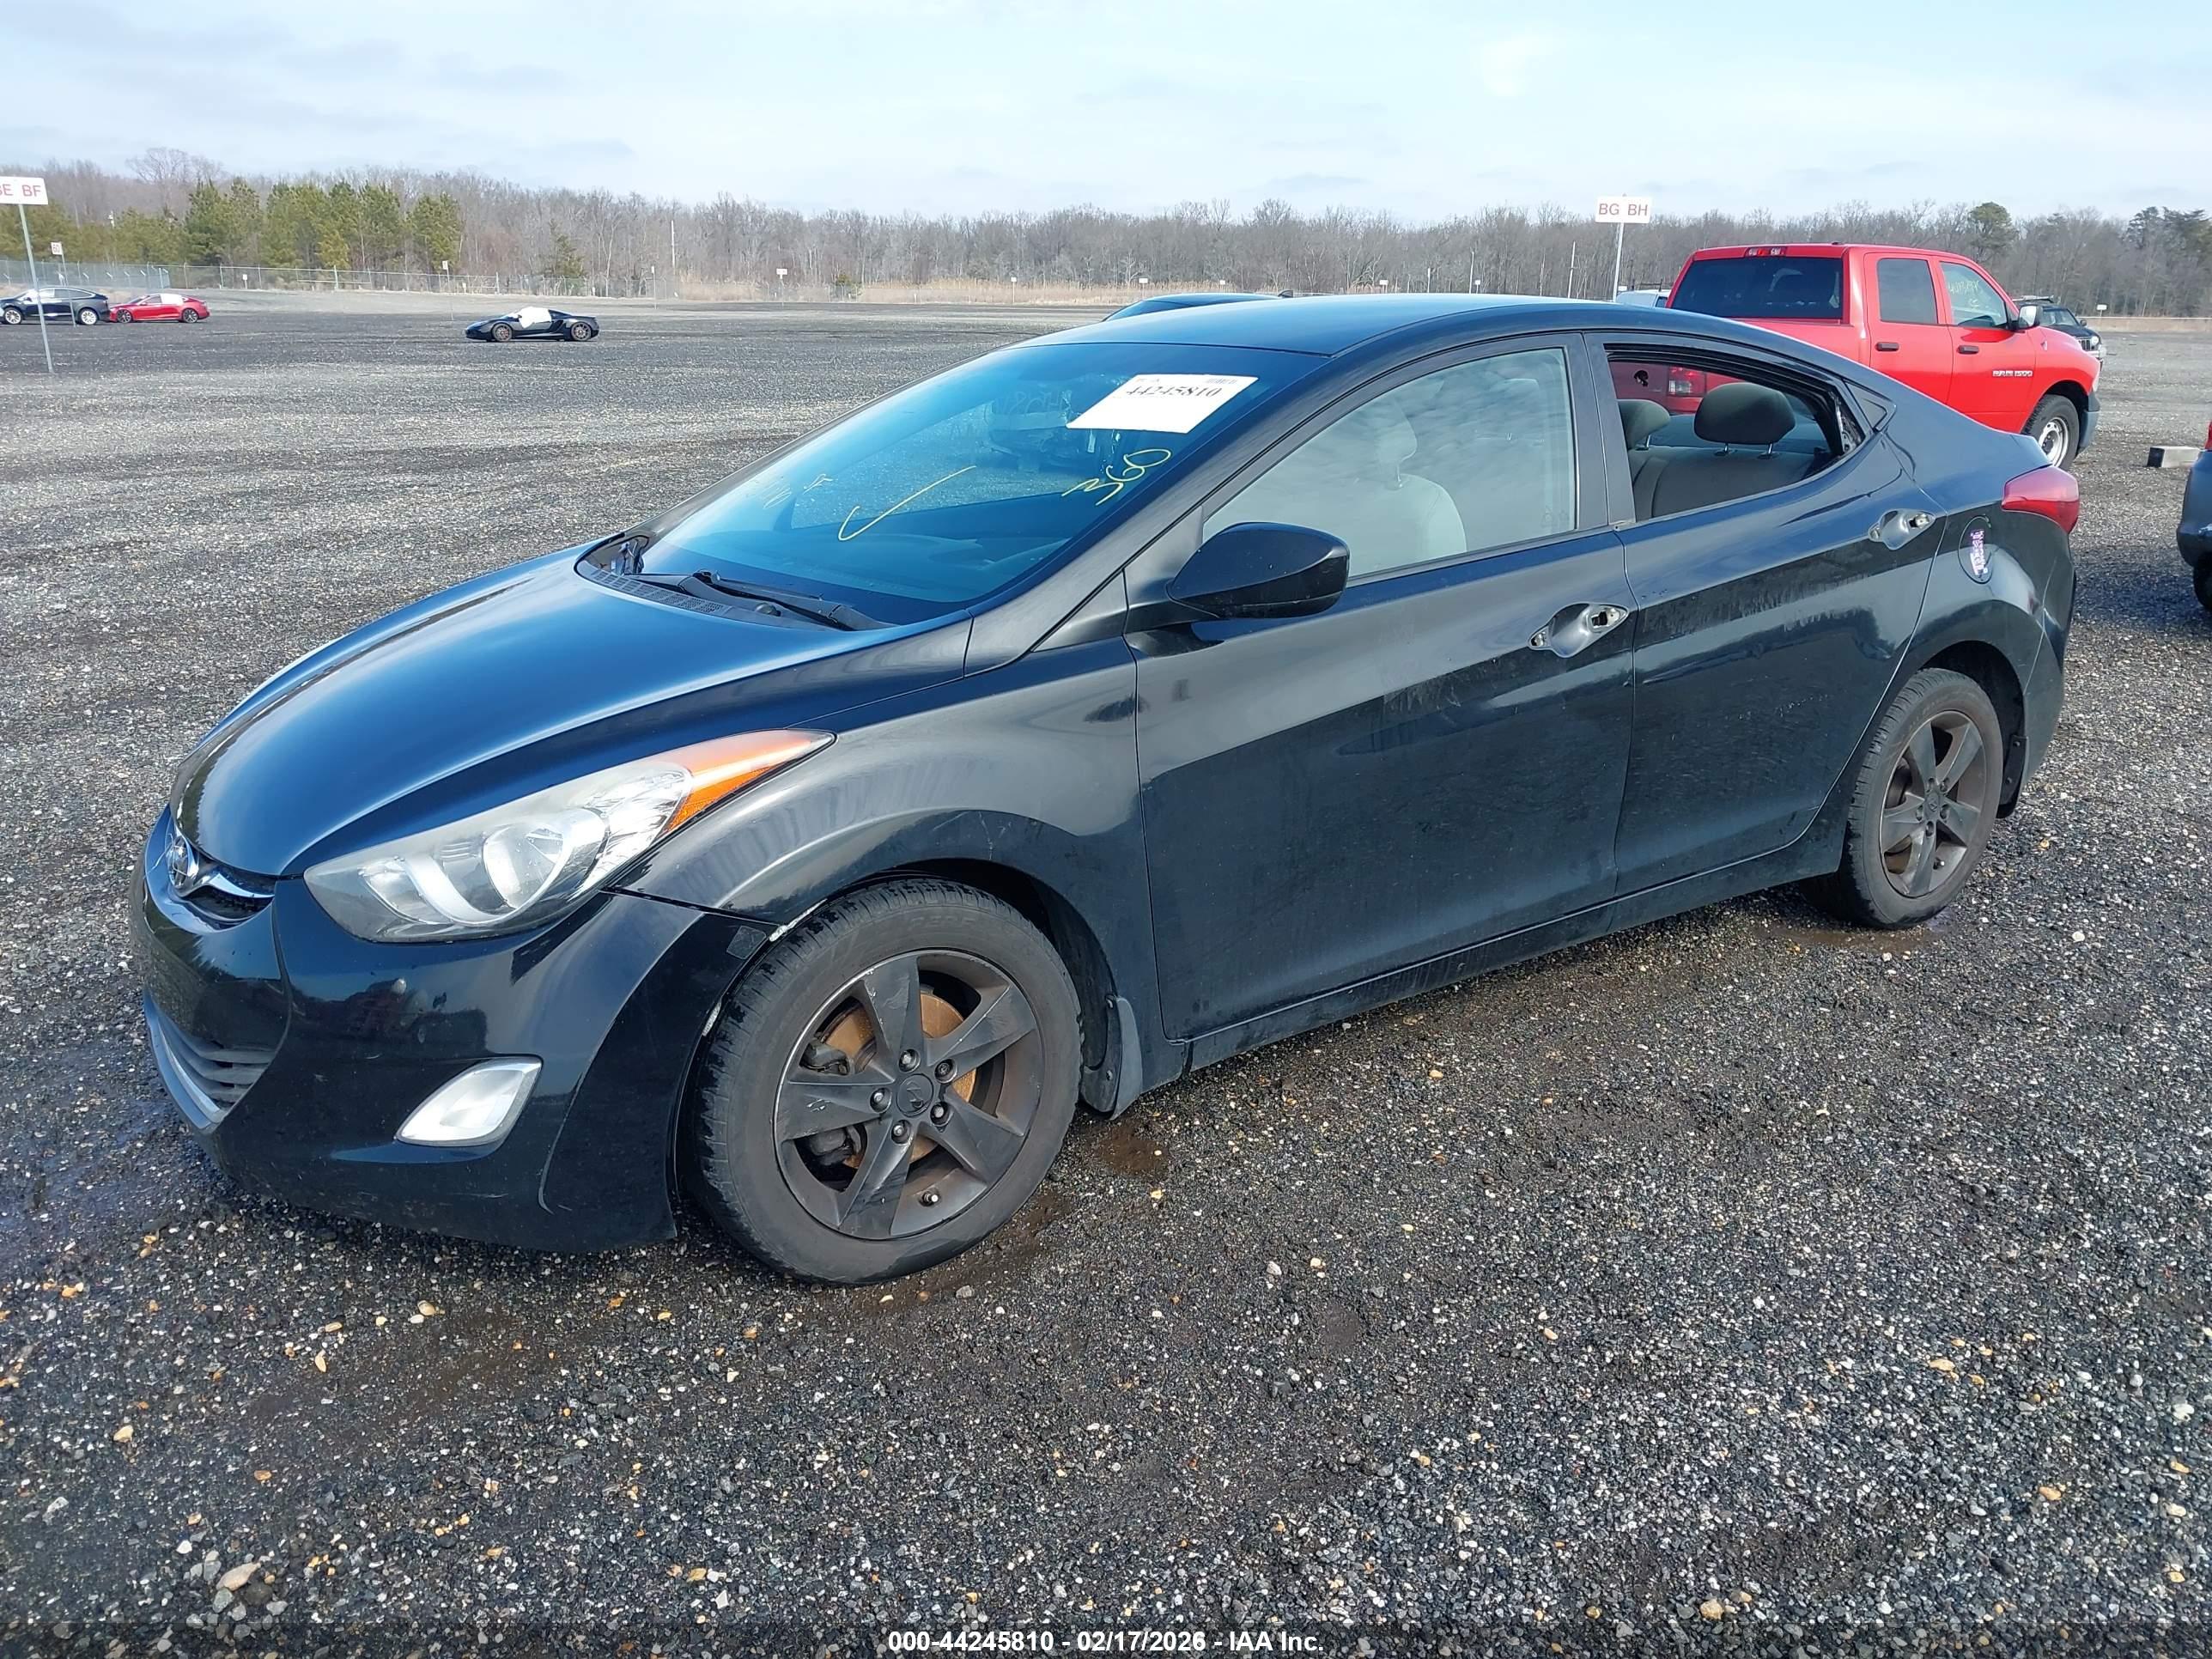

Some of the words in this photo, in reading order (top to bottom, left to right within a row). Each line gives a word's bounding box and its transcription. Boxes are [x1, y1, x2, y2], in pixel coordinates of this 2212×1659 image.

[0, 184, 13, 196] E
[21, 185, 41, 197] BF
[1599, 203, 1620, 216] BG
[1627, 204, 1648, 216] BH
[1127, 386, 1223, 397] 44245810
